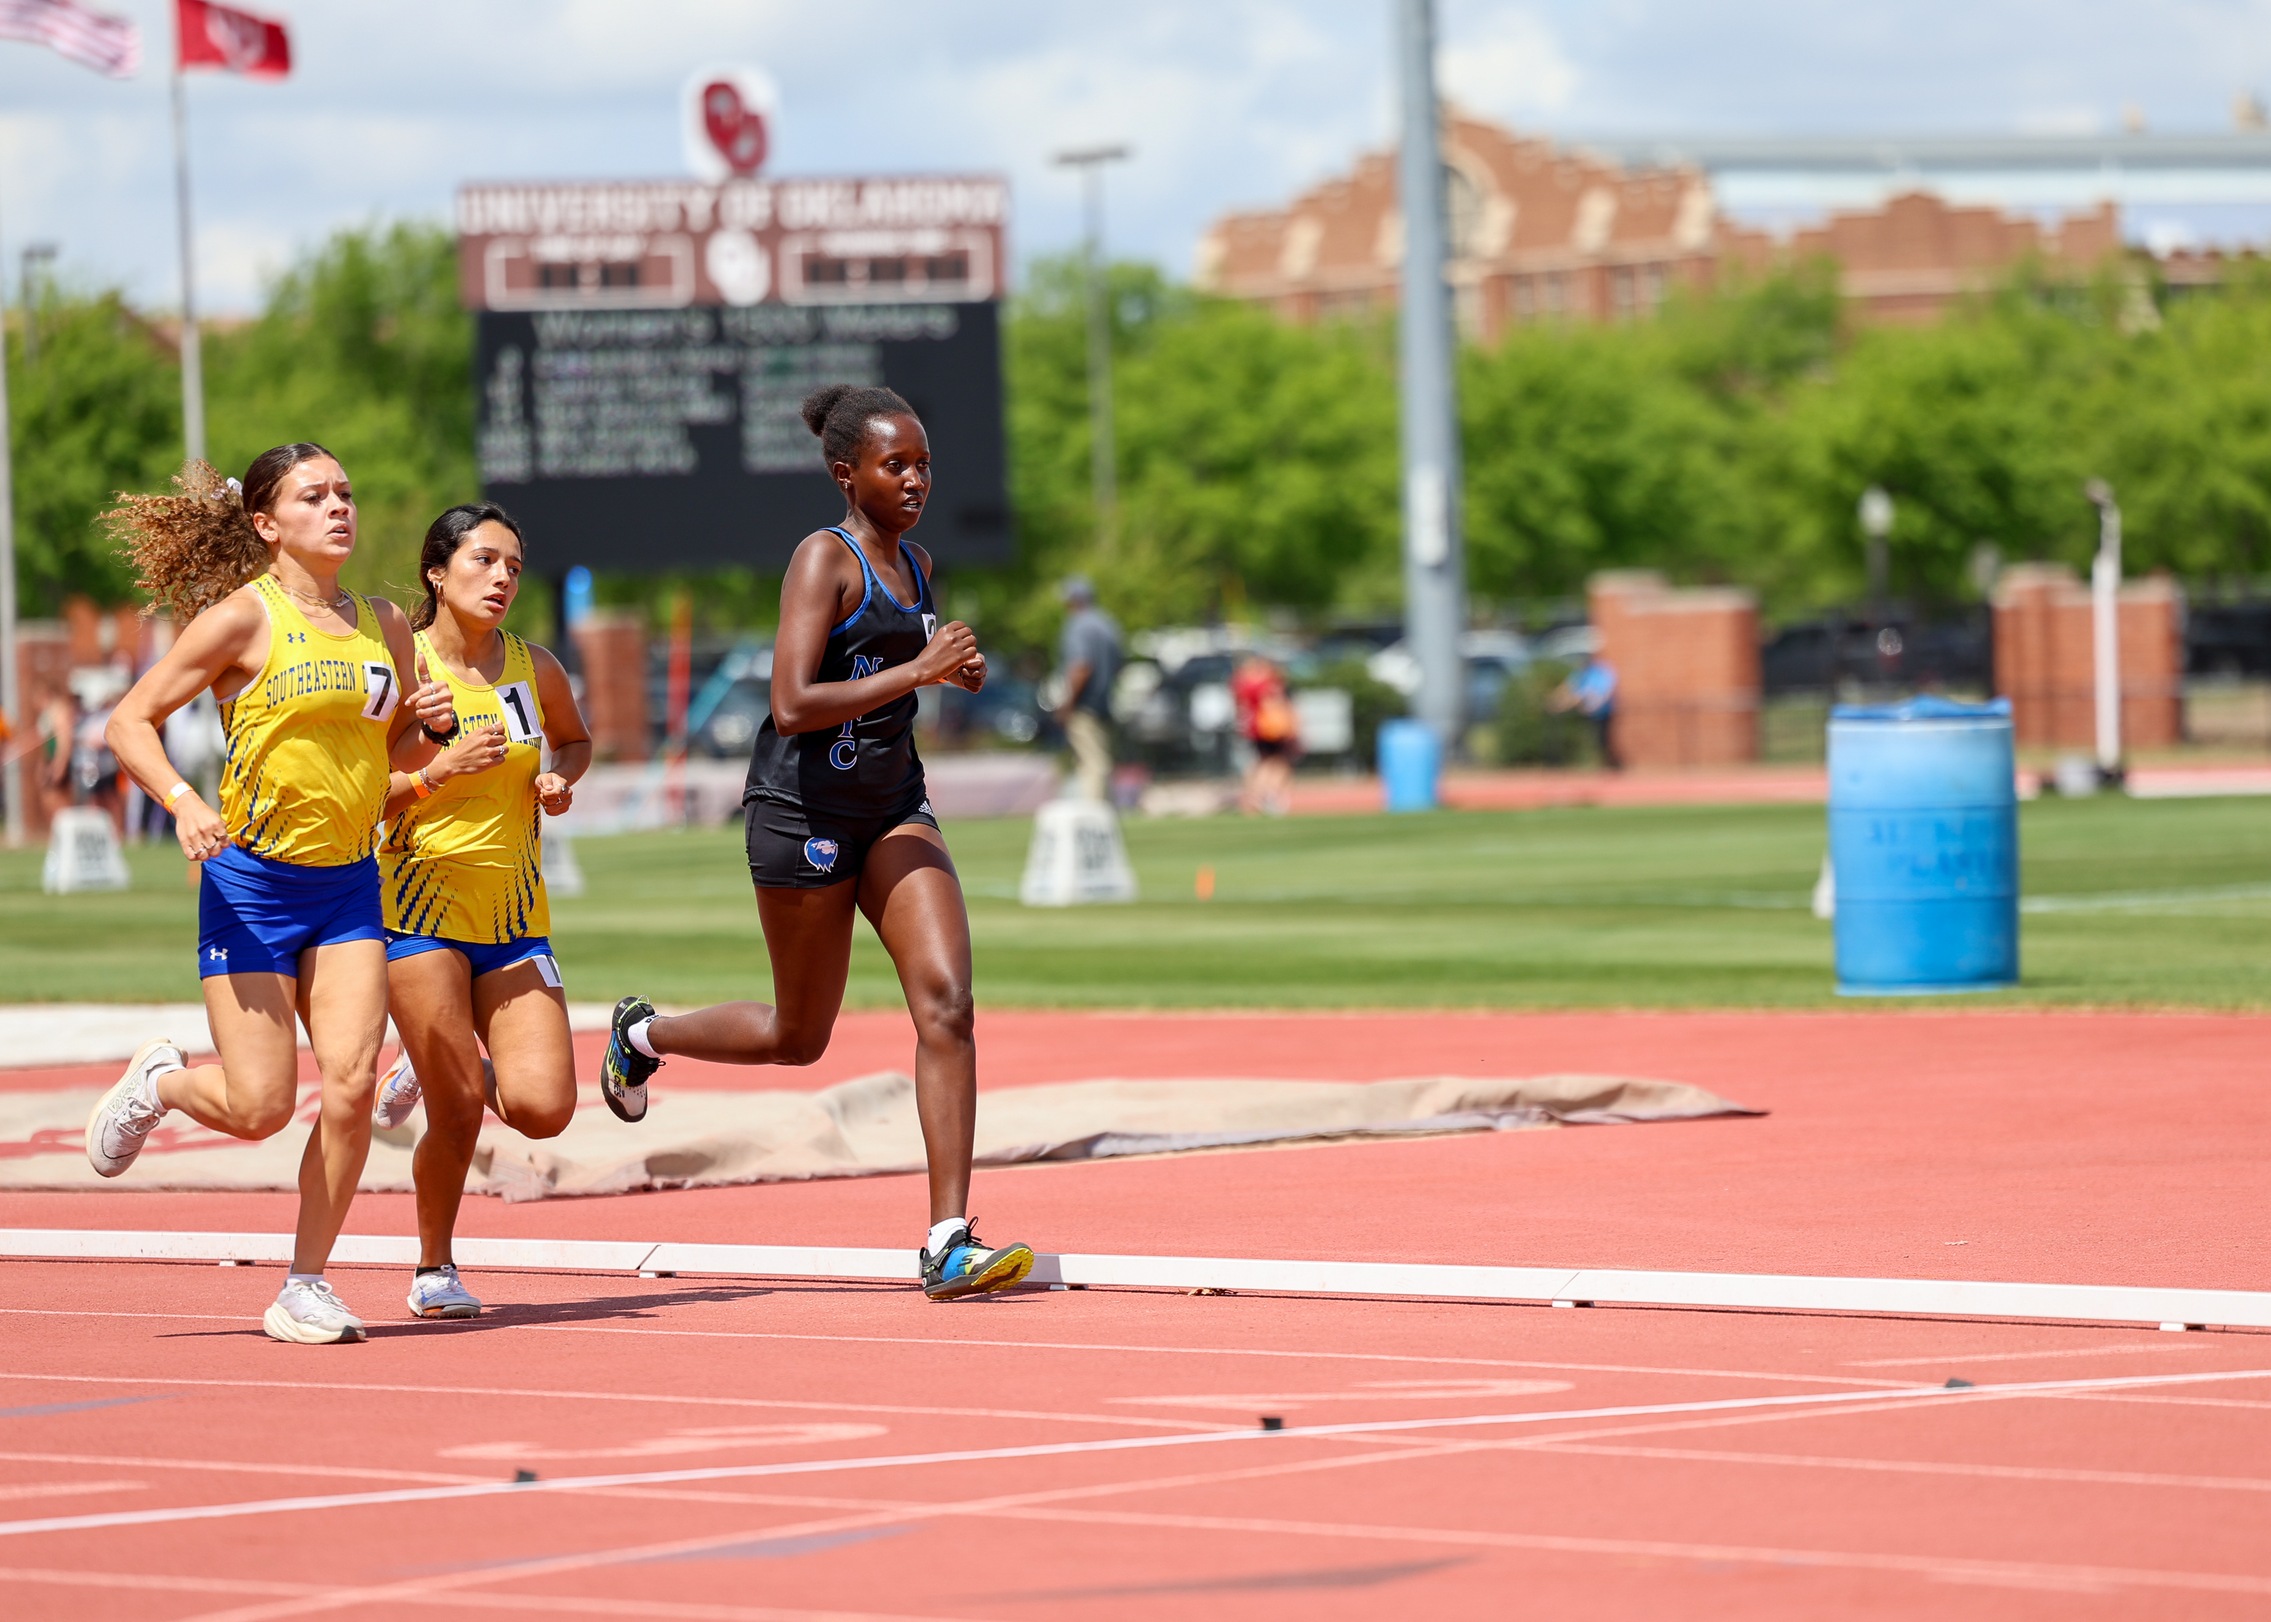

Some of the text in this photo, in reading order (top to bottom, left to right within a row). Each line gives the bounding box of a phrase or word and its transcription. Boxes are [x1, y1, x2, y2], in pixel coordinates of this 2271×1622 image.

[266, 660, 357, 710] SOUTHEASTERN
[370, 666, 392, 717] 7
[503, 687, 532, 736] 1
